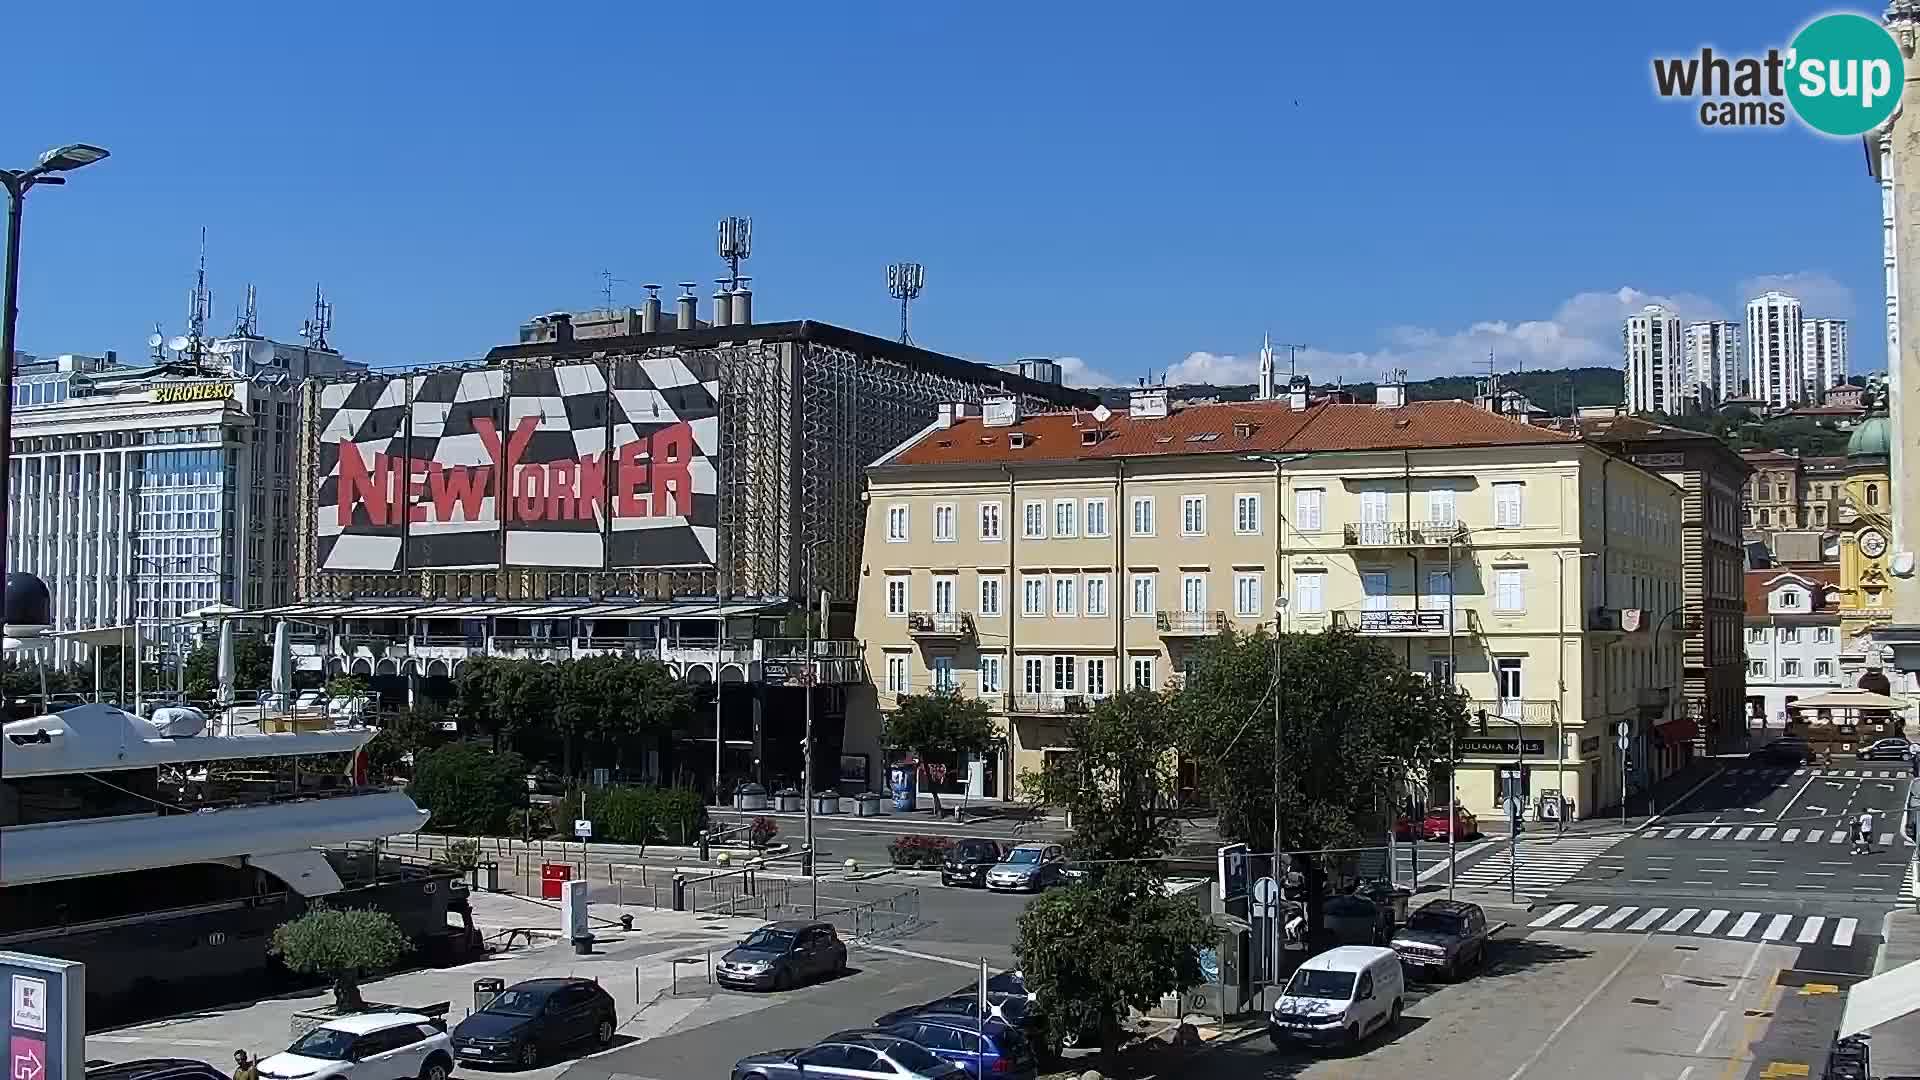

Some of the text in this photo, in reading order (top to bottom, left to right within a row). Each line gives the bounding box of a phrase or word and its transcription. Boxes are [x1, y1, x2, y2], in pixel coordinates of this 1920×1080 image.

[156, 383, 235, 401] EUROHERC
[1458, 743, 1539, 751] JULIANA NAILS
